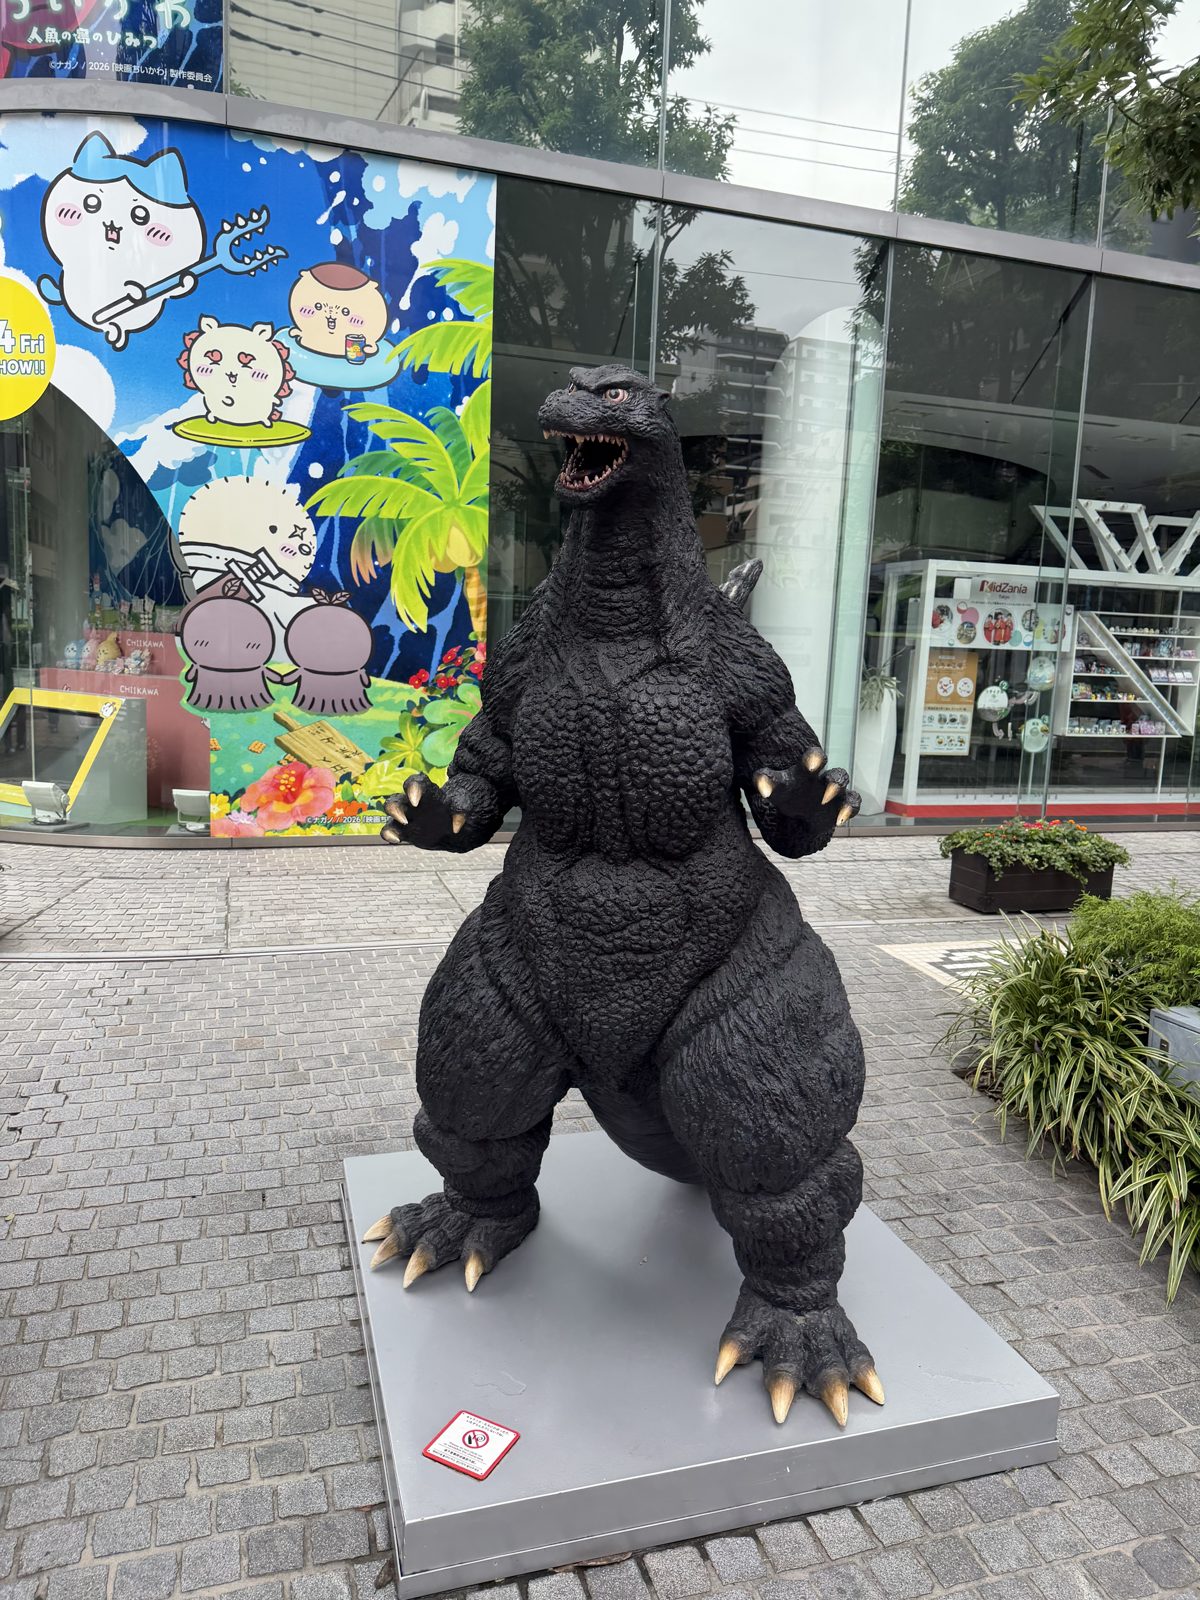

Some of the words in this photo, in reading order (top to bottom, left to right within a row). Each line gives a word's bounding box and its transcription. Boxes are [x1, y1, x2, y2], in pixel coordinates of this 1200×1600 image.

[27, 26, 157, 48] 人魚の島のひみつ
[20, 334, 45, 353] Fri
[979, 580, 1028, 594] KidZania
[126, 638, 164, 648] CHIIKAWA
[120, 685, 159, 696] CHIIKAWA
